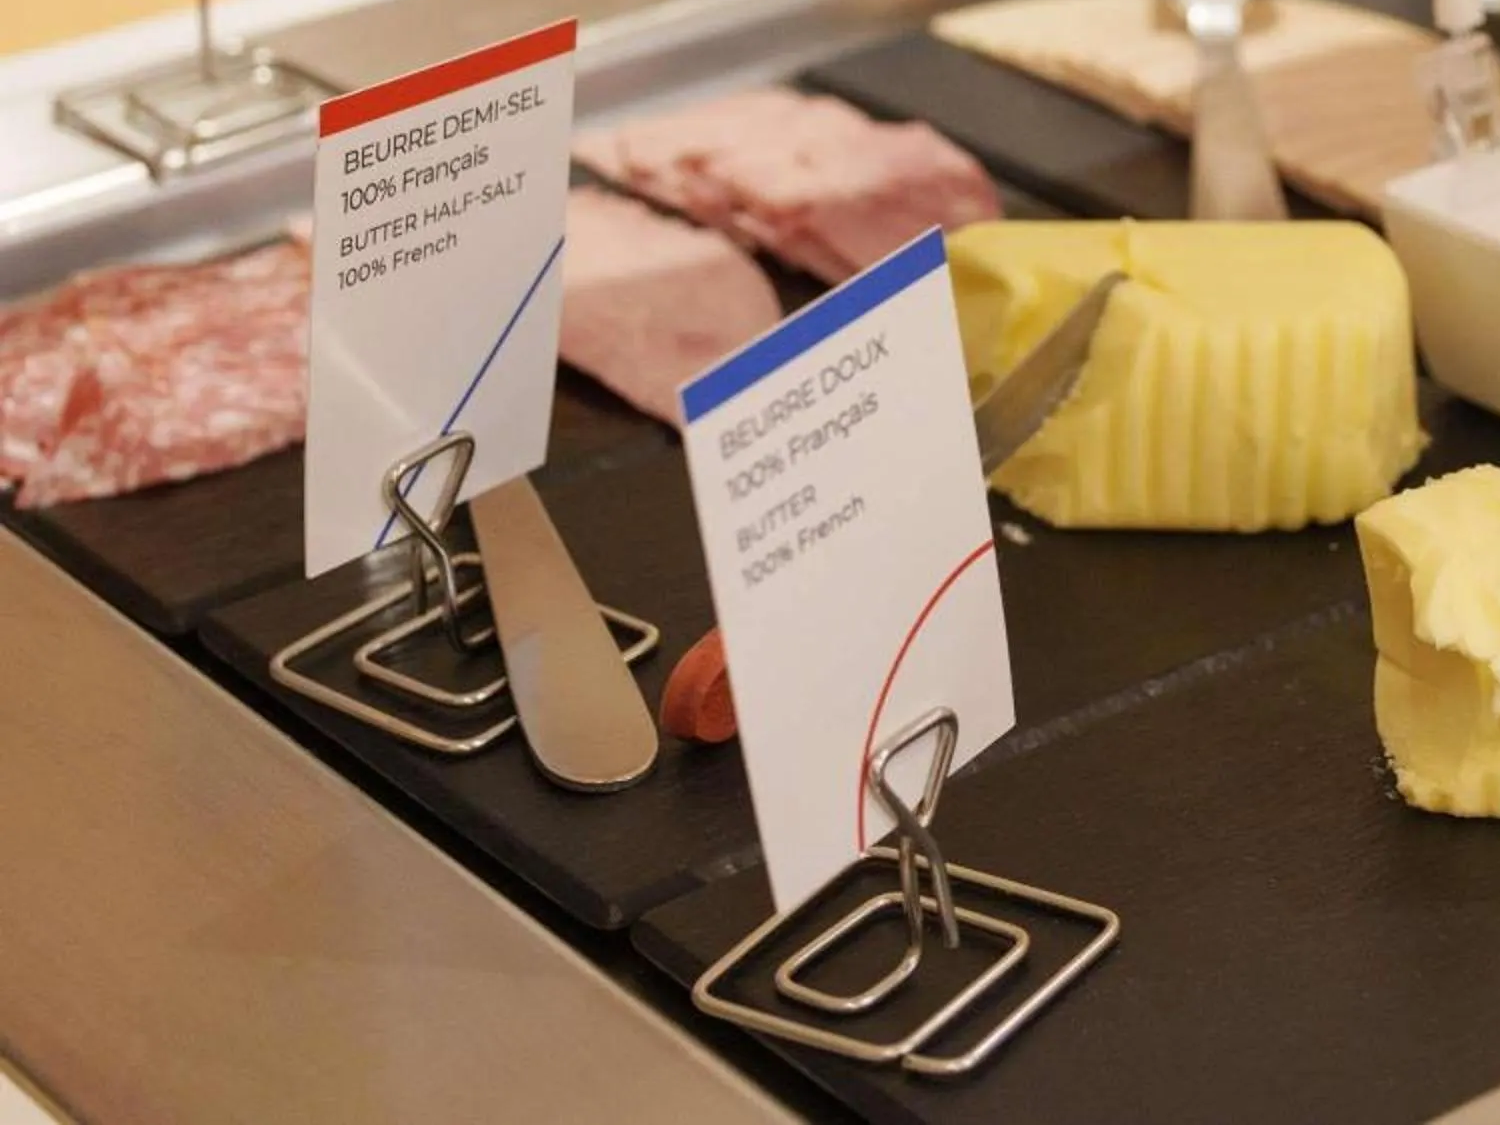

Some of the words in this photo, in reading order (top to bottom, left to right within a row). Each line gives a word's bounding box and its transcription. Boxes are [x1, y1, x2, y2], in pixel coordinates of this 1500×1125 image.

[344, 122, 437, 175] BEURRE
[443, 85, 546, 141] DEMI-SEL
[339, 212, 417, 258] BUTTER
[423, 172, 526, 227] HALF-SALT
[340, 174, 397, 214] 100%
[402, 144, 490, 193] Français
[337, 257, 387, 290] 100%
[392, 231, 458, 272] French
[718, 378, 817, 462] BEURRE
[819, 332, 890, 397] DOUX
[725, 447, 786, 502] 100%
[787, 390, 879, 465] Français
[735, 483, 817, 553] BUTTER
[741, 540, 795, 588] 100%
[796, 494, 865, 554] French
